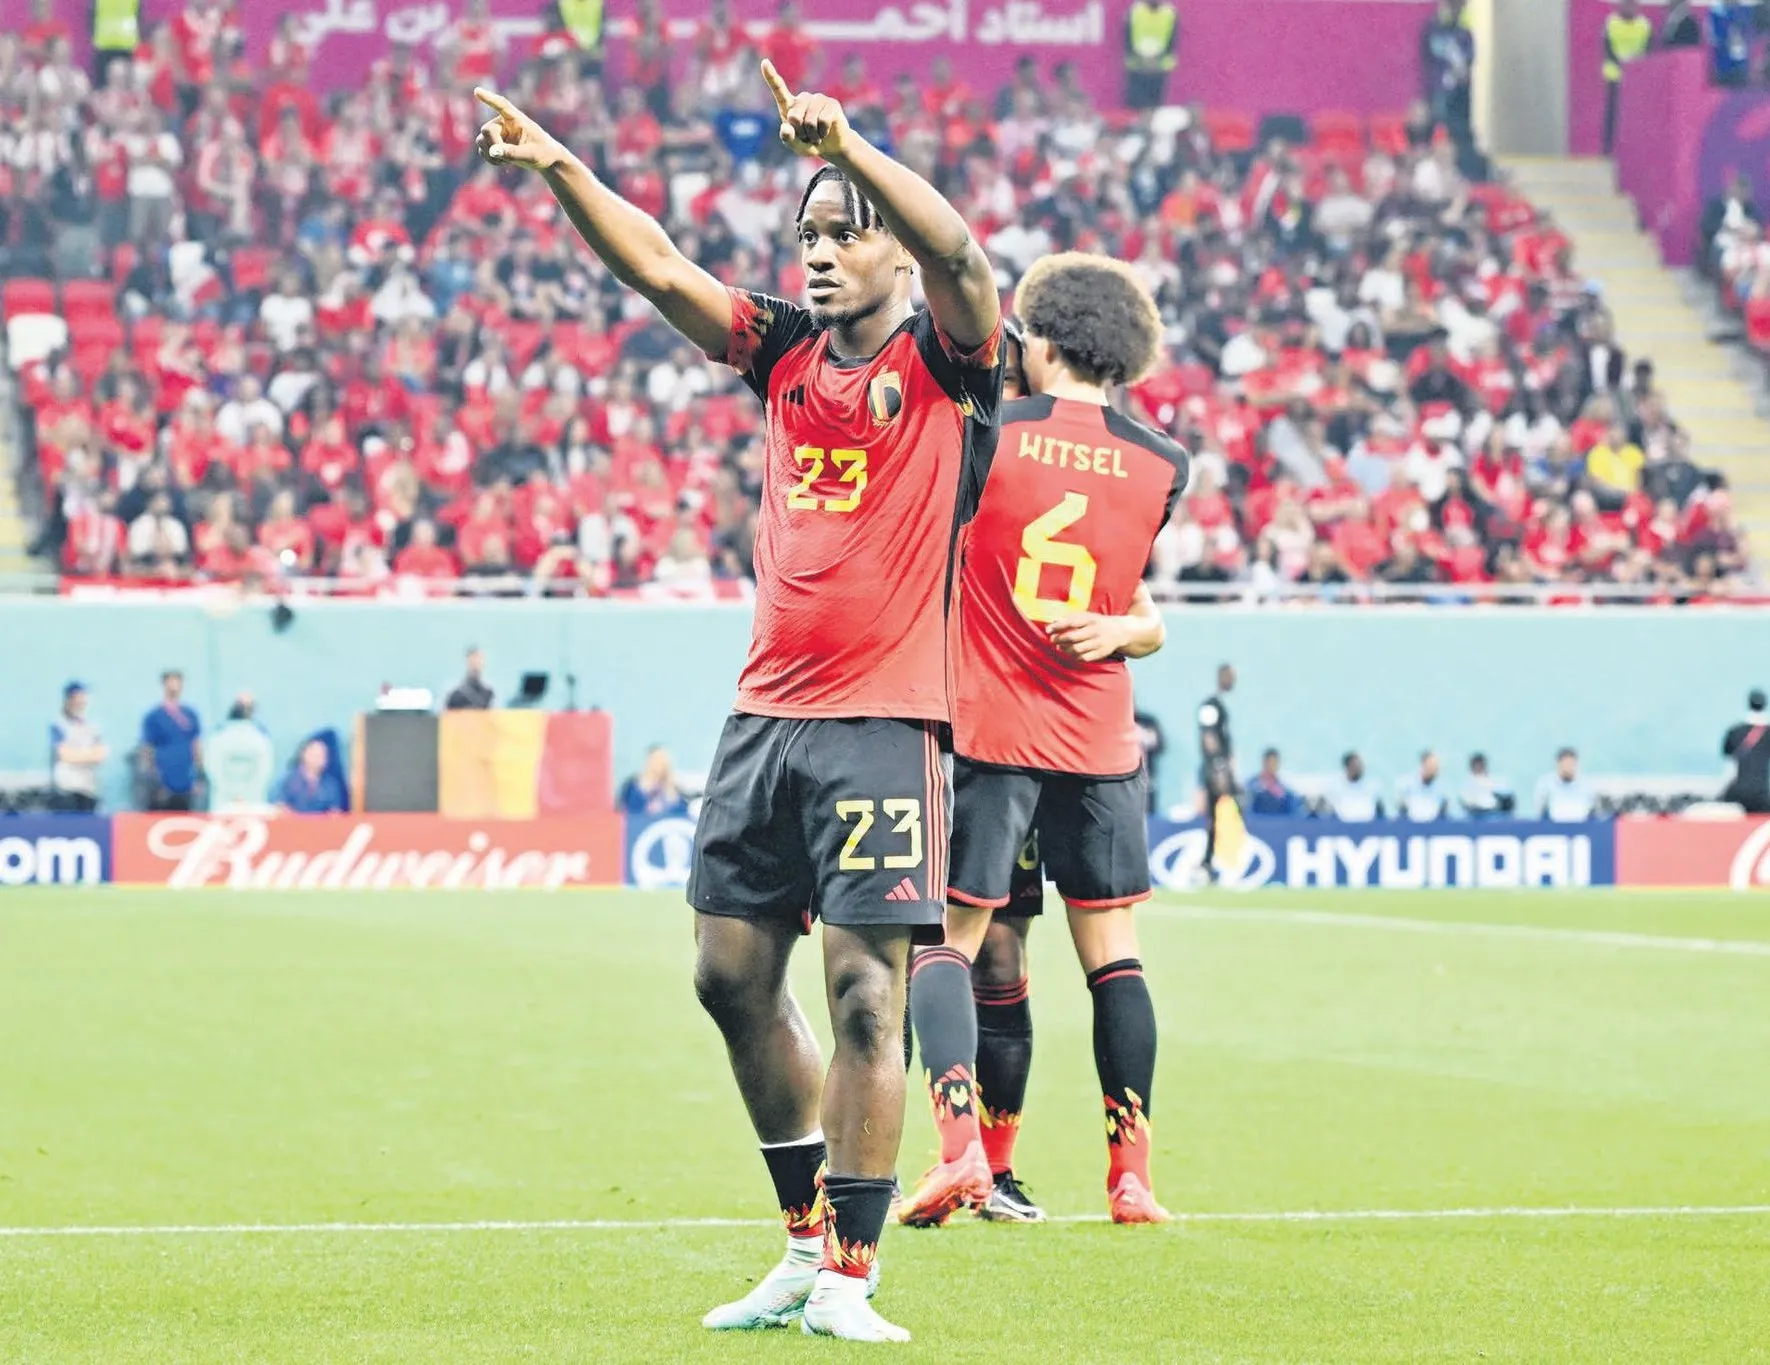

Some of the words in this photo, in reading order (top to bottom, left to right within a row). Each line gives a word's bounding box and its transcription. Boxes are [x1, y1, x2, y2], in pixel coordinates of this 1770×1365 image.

[787, 445, 868, 513] 23
[1019, 432, 1128, 478] WITSEL
[1013, 491, 1097, 622] 6
[147, 817, 590, 890] Budweiser
[836, 799, 922, 871] 23
[1286, 834, 1590, 889] HYUNDAI
